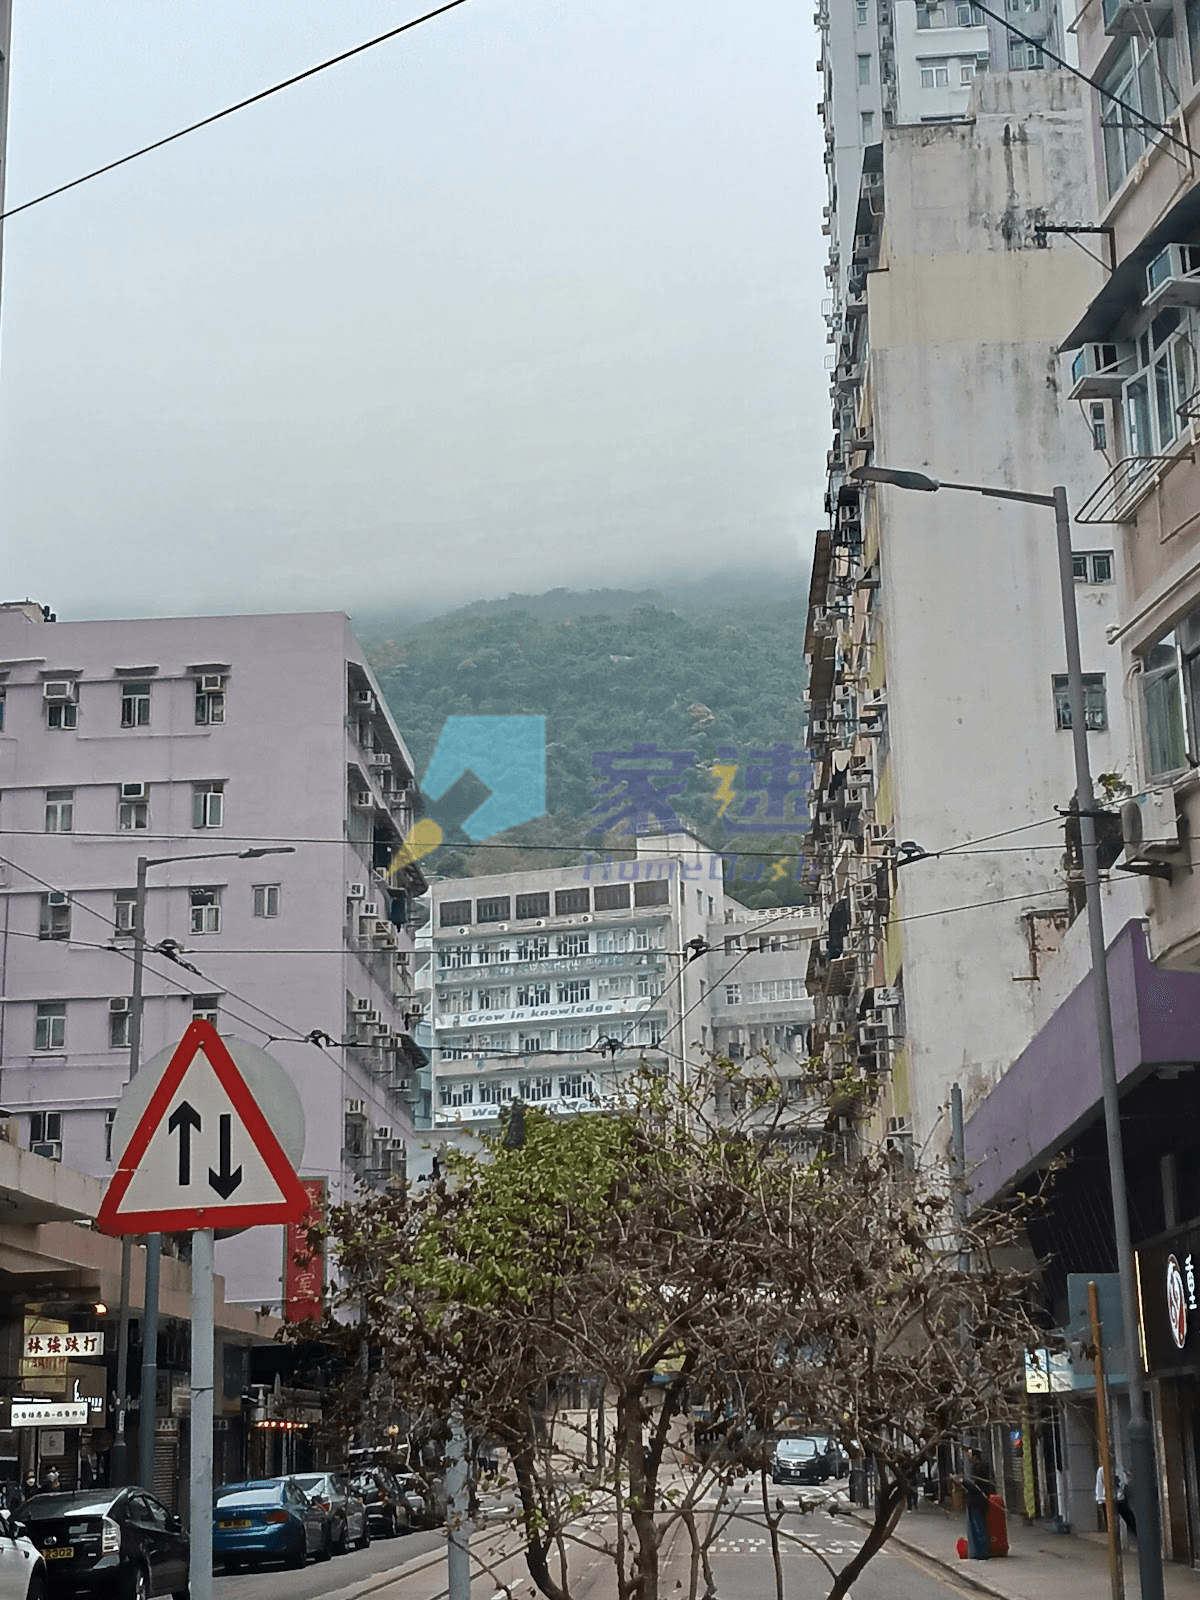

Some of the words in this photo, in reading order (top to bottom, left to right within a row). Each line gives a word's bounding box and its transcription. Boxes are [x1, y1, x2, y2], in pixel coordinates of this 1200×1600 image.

[467, 1013, 505, 1023] Grow
[510, 1009, 525, 1019] in
[531, 1003, 613, 1017] knowledge
